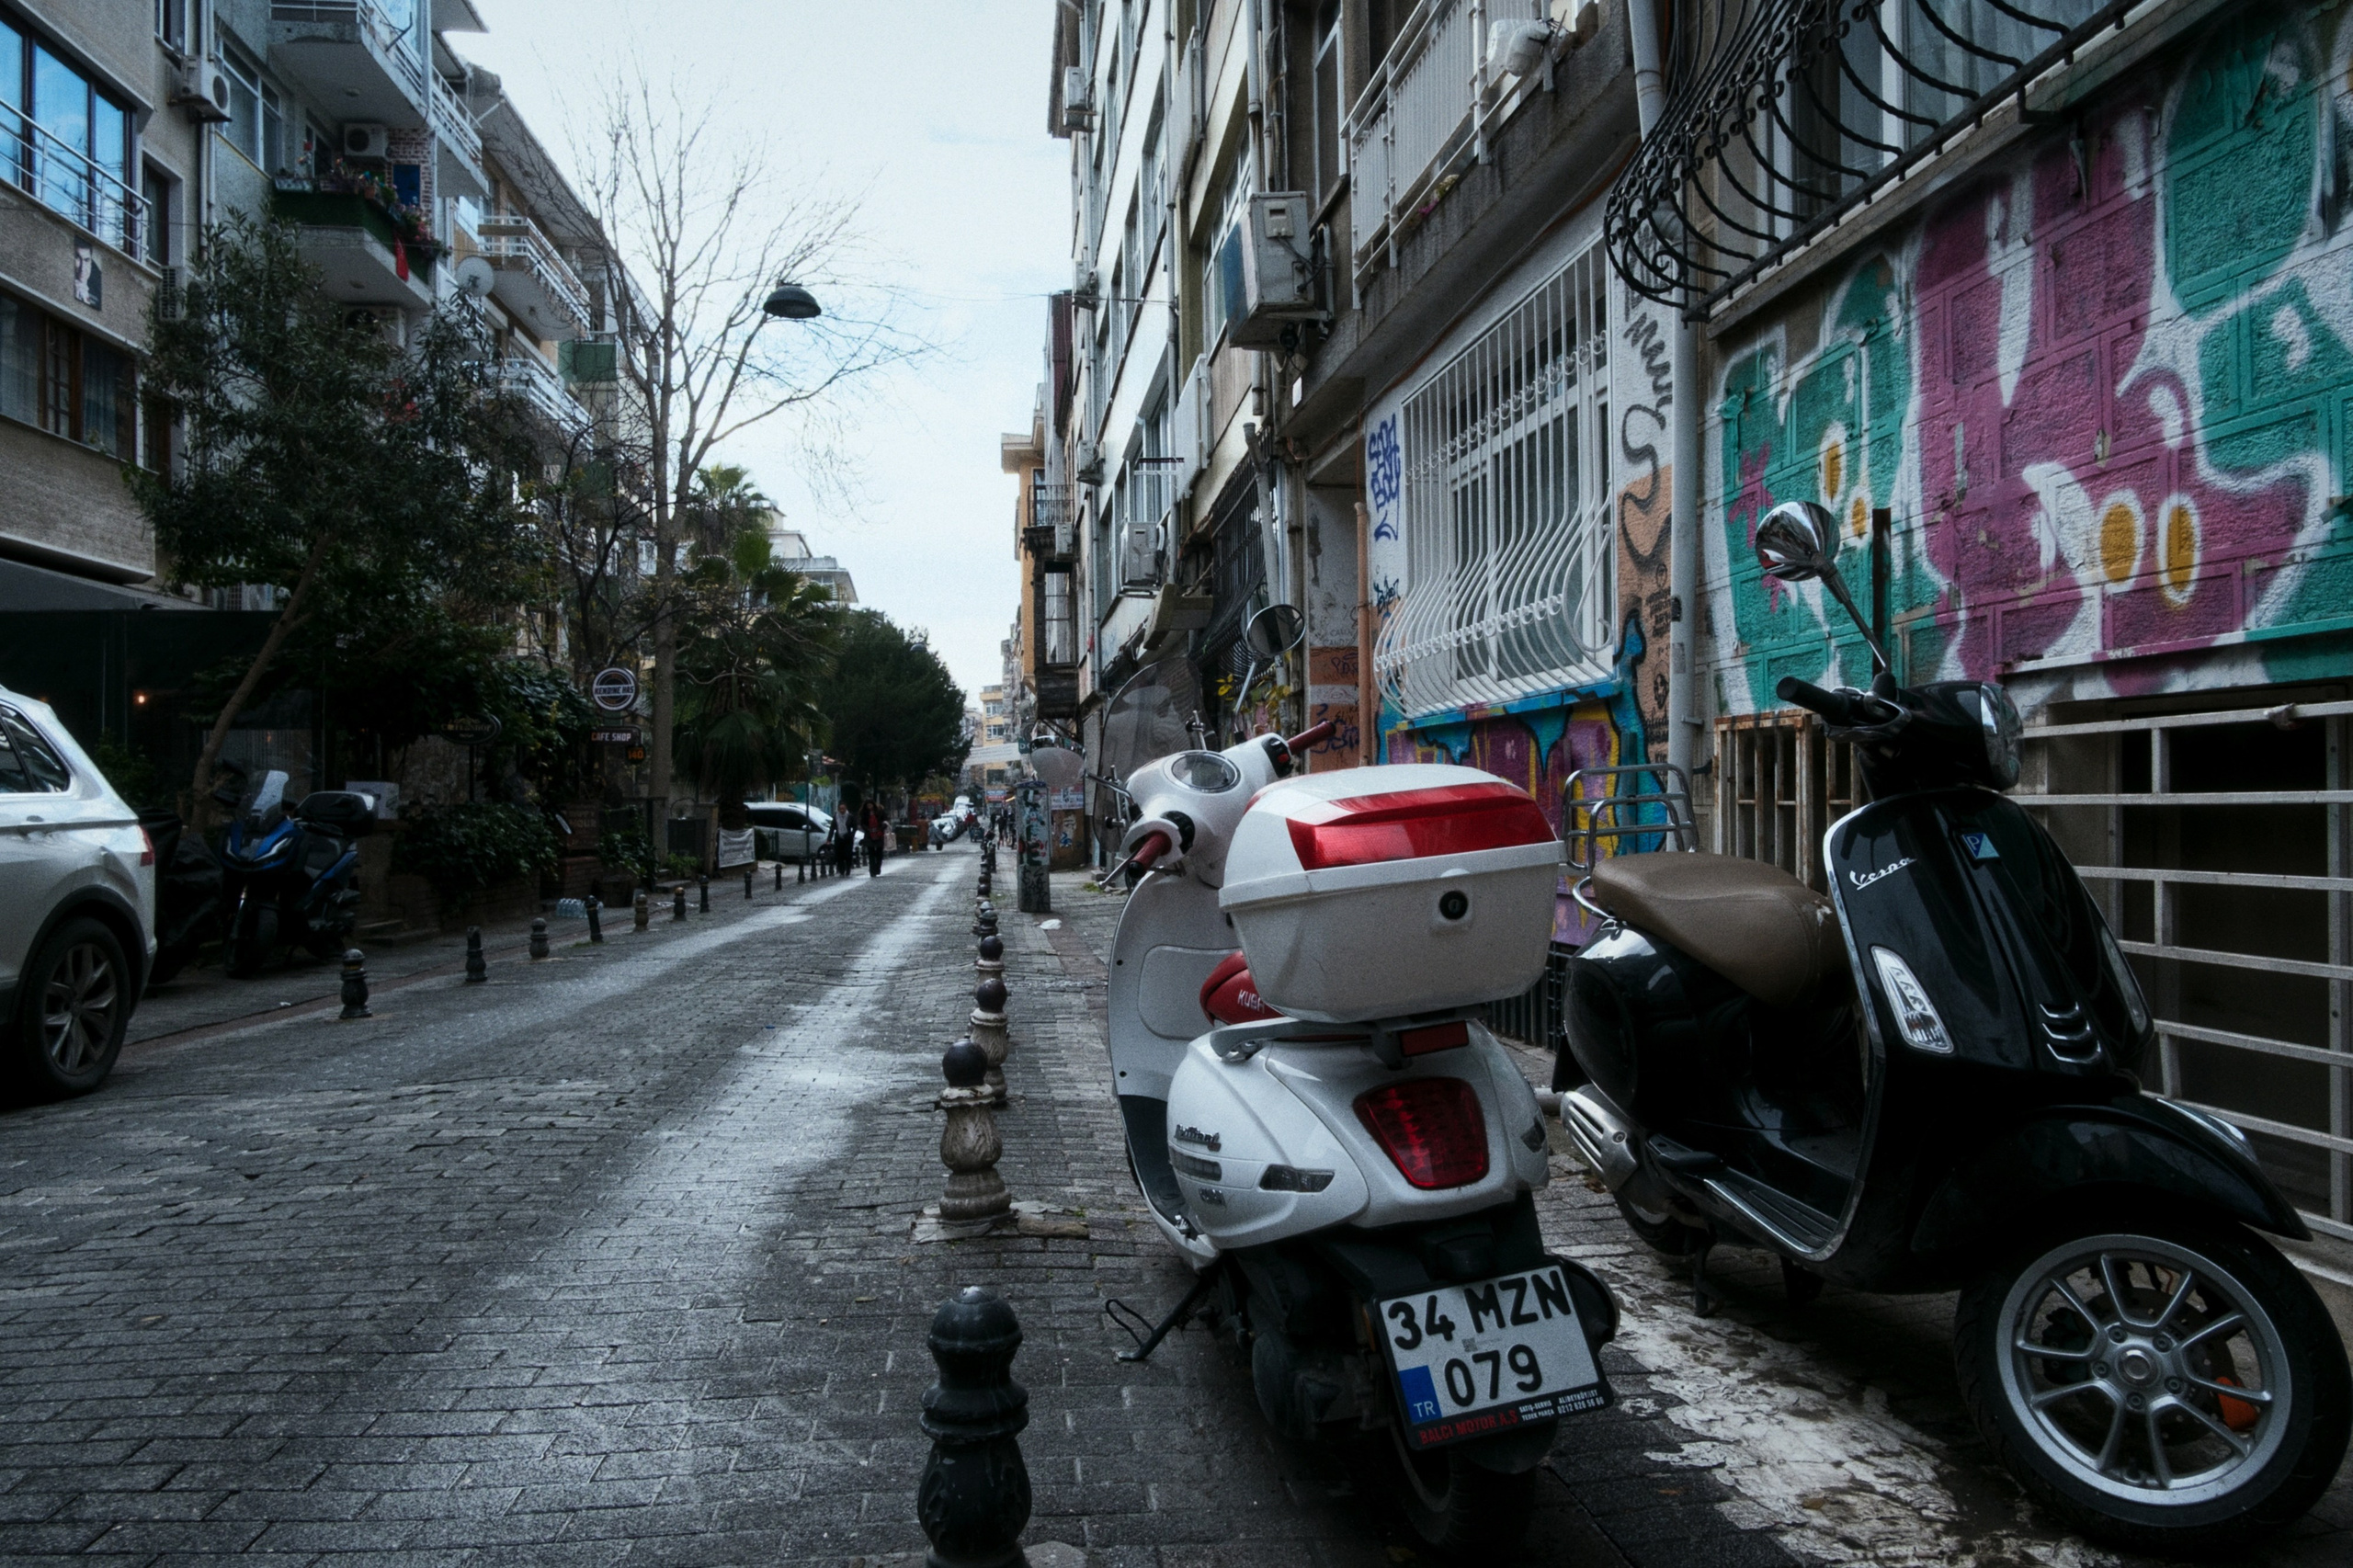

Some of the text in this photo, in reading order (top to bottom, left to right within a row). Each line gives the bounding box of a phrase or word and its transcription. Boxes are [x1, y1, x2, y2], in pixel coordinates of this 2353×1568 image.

[591, 733, 631, 742] CAFE SHOP
[1848, 857, 1917, 891] Vespa
[1388, 1269, 1572, 1350] 34 MZN
[1444, 1344, 1542, 1407] 079
[1413, 1401, 1436, 1418] TR
[1557, 1403, 1574, 1415] 0212
[1455, 1415, 1497, 1436] MOTOR
